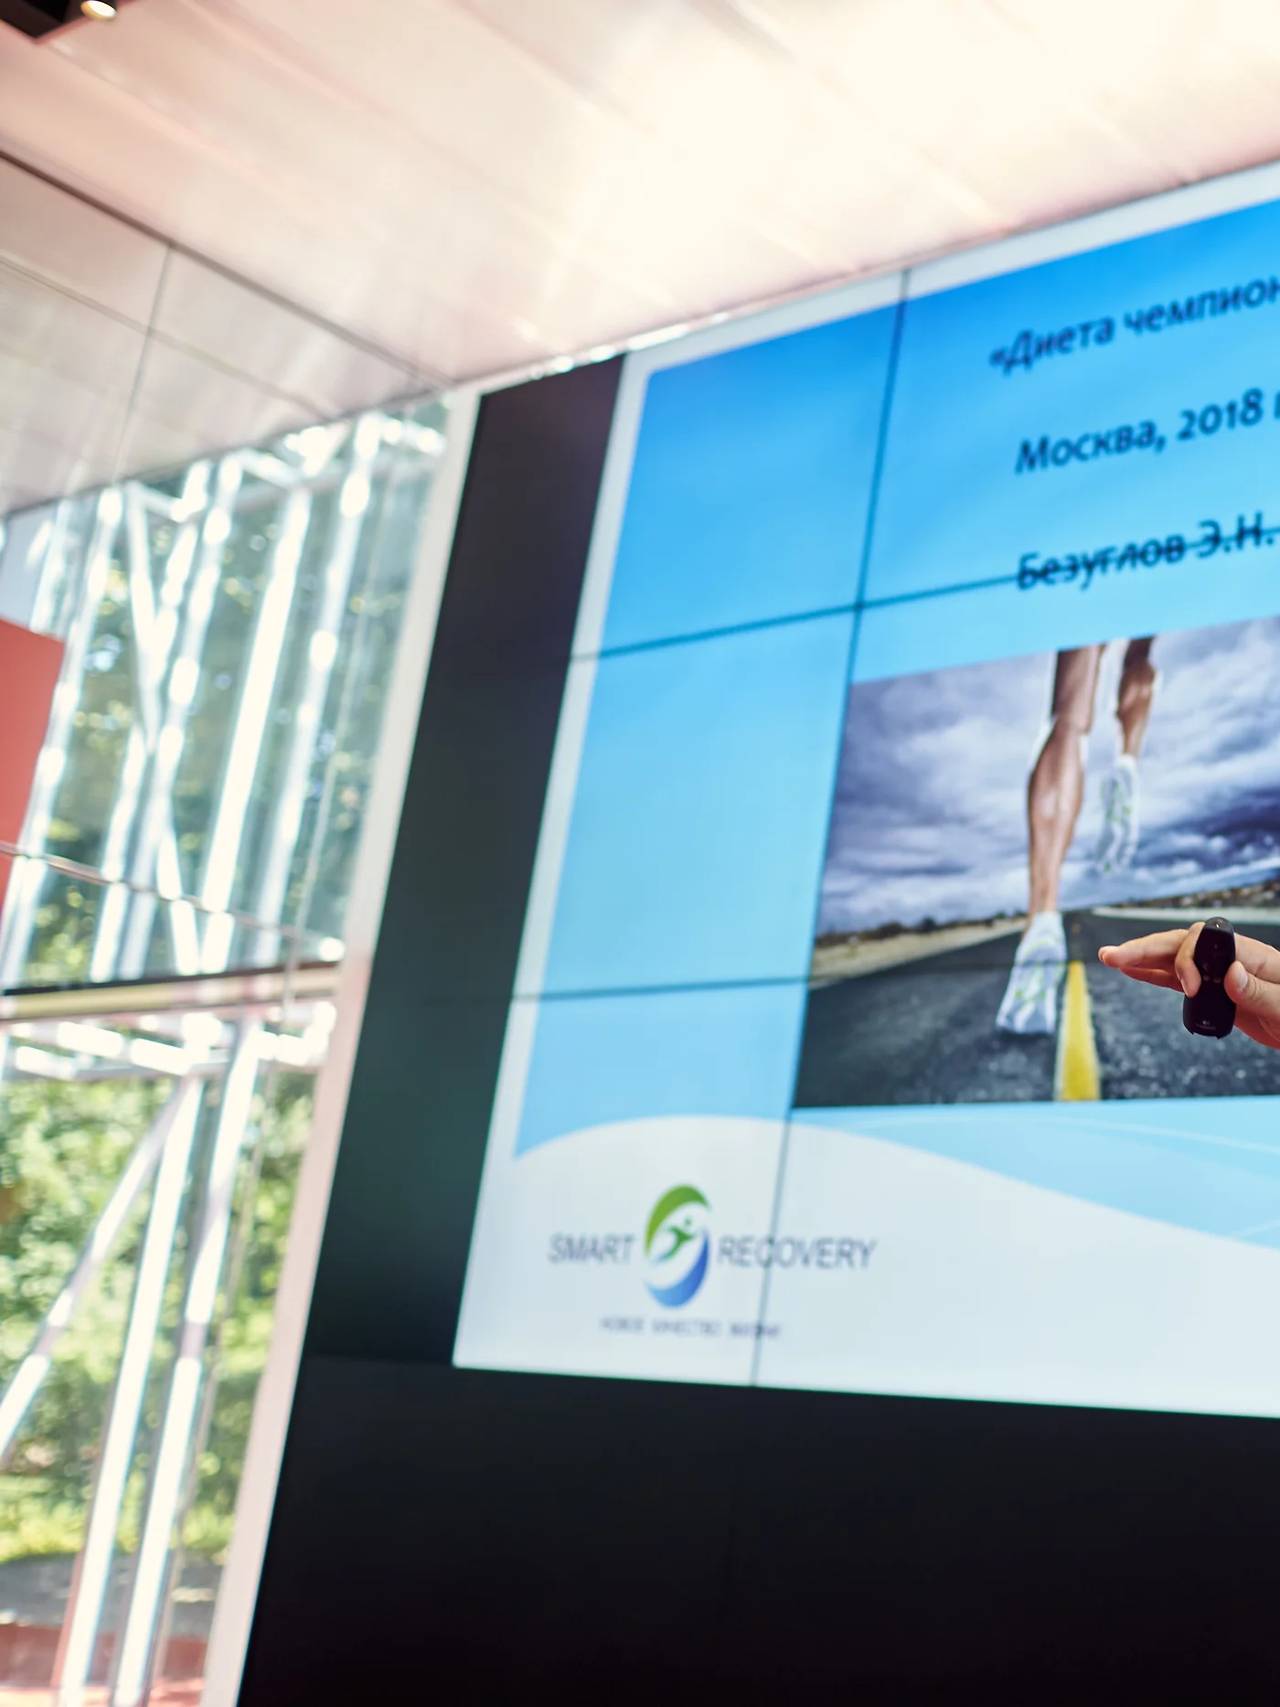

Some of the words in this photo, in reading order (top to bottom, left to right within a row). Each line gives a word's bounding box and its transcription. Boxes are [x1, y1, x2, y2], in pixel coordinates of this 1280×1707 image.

[1014, 420, 1166, 475] Москва,
[1177, 387, 1264, 441] 2018
[1016, 532, 1187, 591] Безуглов
[1196, 511, 1276, 559] Э.Н.
[547, 1232, 636, 1266] SMART
[716, 1234, 878, 1271] RECOVERY
